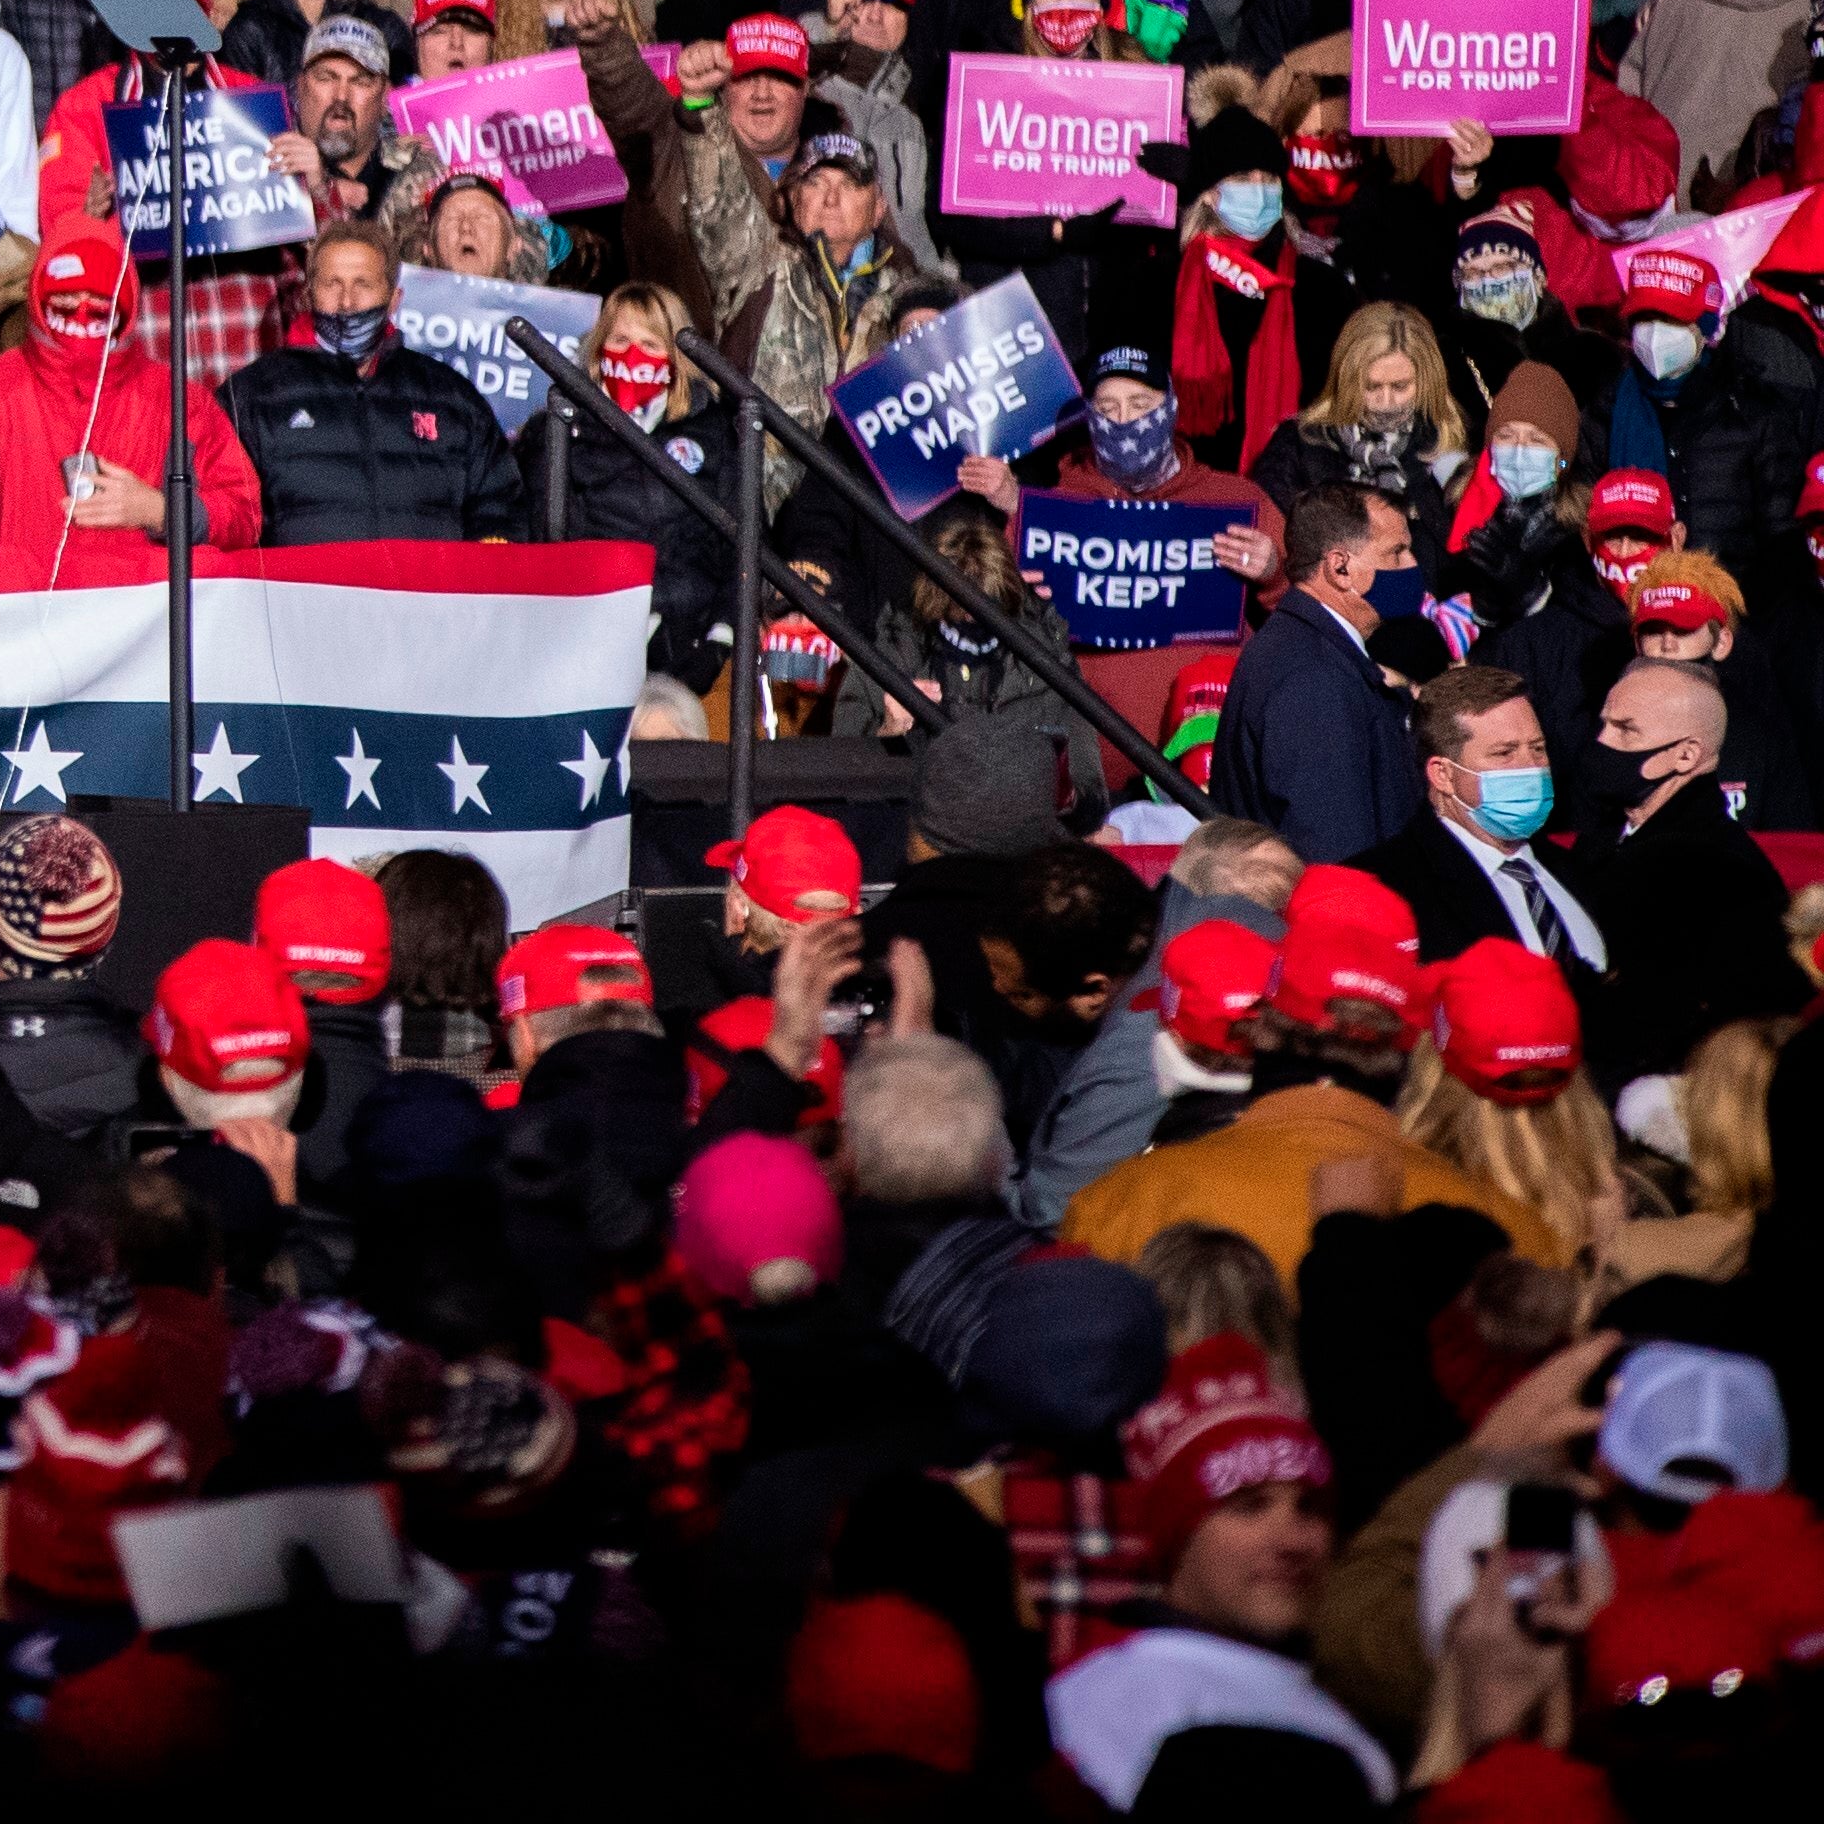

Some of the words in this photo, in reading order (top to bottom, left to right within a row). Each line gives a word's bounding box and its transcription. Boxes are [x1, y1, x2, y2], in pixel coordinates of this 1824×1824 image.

[1382, 20, 1556, 69] Women
[1402, 71, 1452, 90] FOR
[1460, 71, 1541, 90] TRUMP
[428, 103, 599, 162] Women
[977, 100, 1148, 155] Women
[512, 143, 590, 175] TRUMP
[994, 155, 1042, 174] FOR
[1052, 156, 1130, 178] TRUMP
[201, 178, 302, 219] AGAIN
[855, 319, 1045, 445] PROMISES
[909, 373, 1028, 459] MADE
[1025, 528, 1215, 573] PROMISE
[1075, 575, 1187, 610] KEPT
